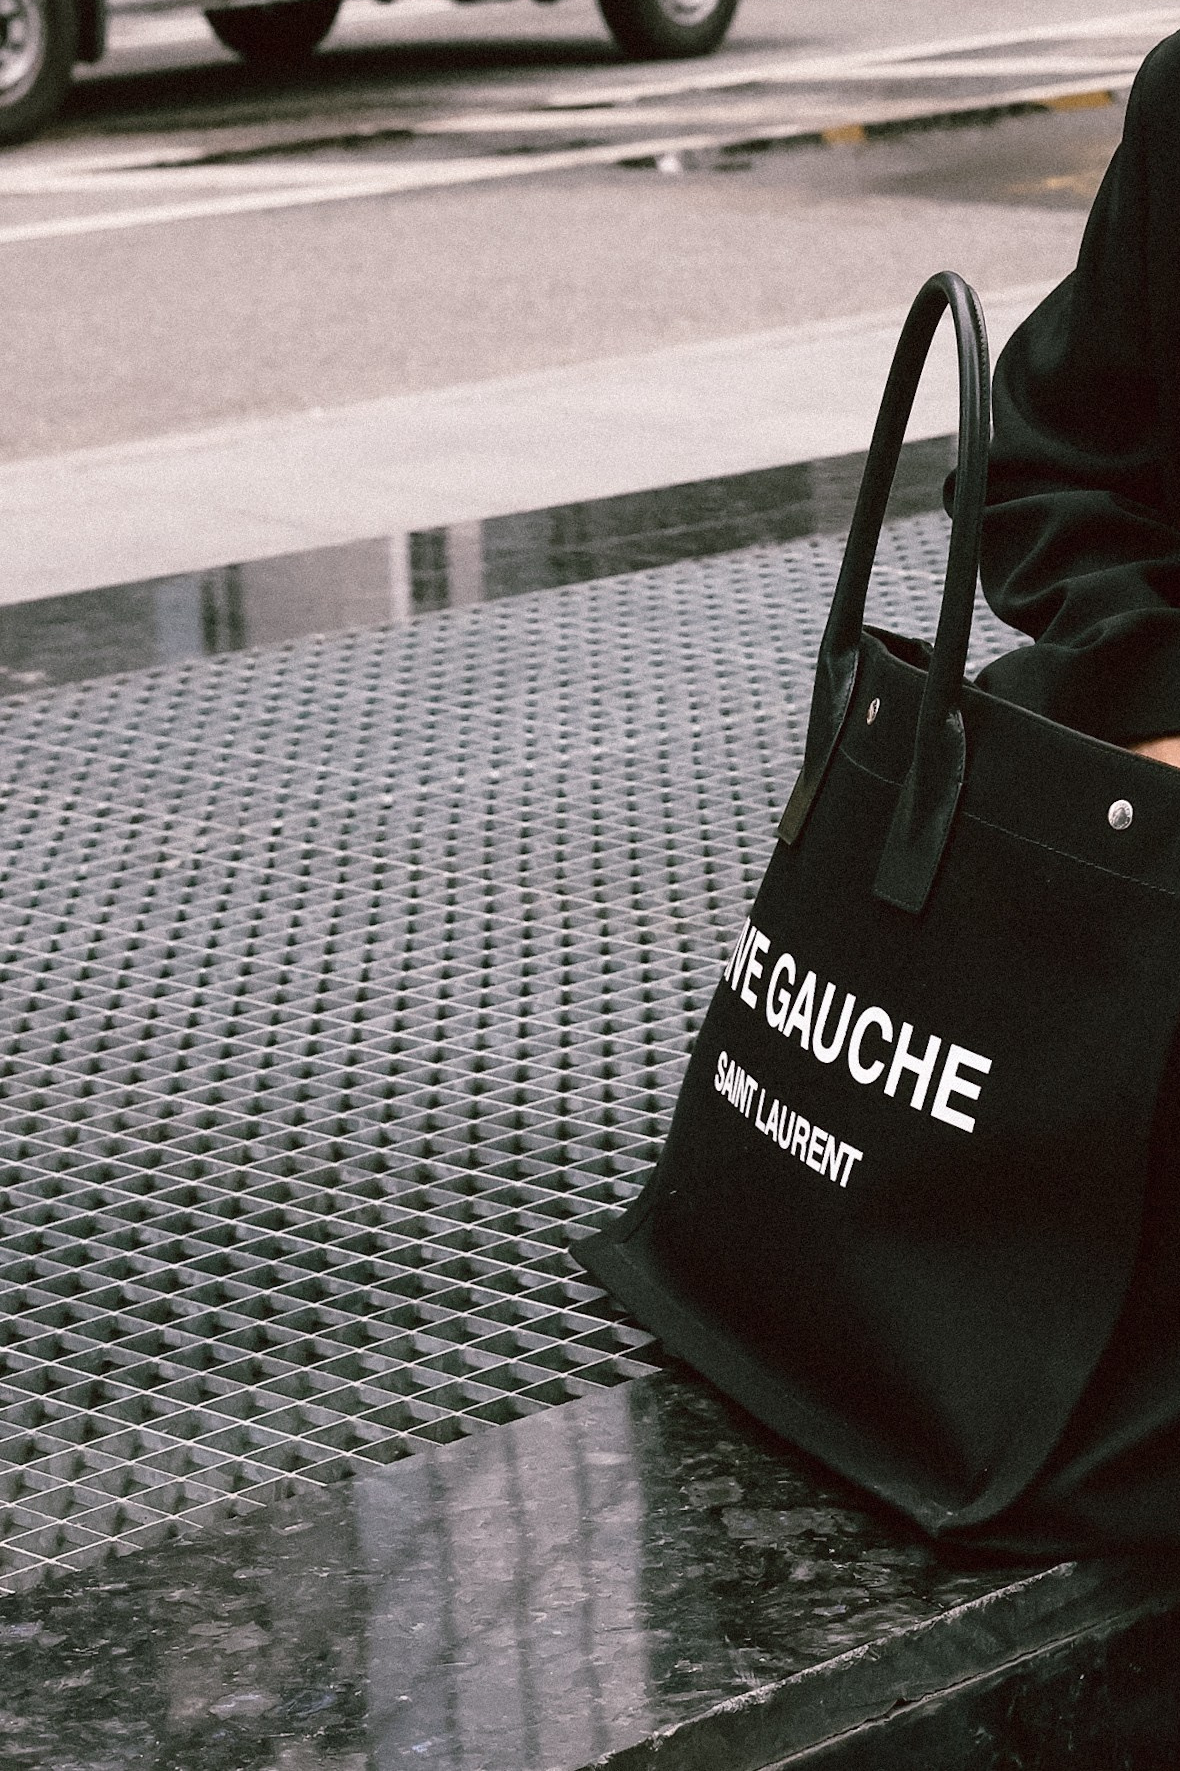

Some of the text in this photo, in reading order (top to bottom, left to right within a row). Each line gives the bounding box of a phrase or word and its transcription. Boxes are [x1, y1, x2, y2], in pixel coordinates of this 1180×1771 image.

[724, 916, 992, 1133] IVE GAUCHE
[714, 1051, 863, 1188] SAINT LAURENT
